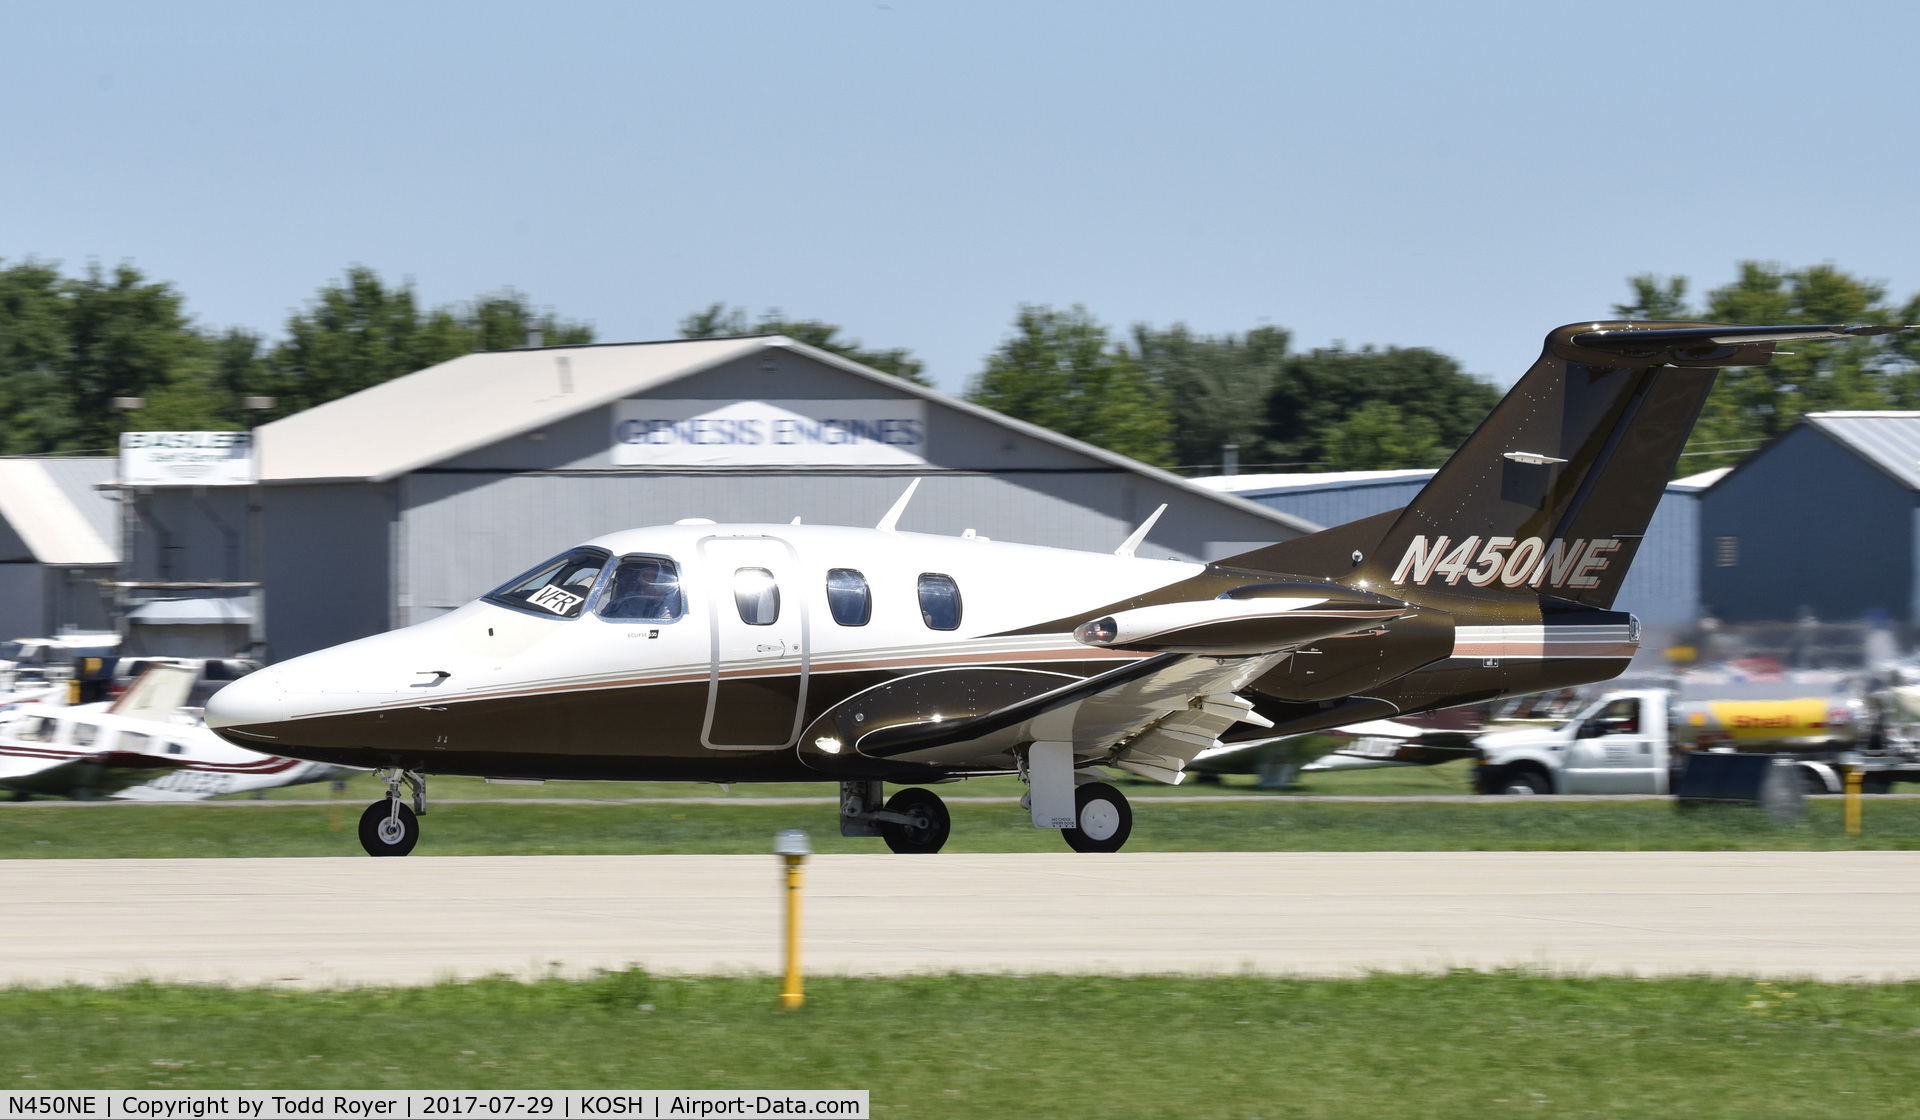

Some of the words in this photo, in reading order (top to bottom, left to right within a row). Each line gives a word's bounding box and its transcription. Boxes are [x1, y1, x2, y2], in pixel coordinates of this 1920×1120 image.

[616, 419, 763, 445] GENESIS
[774, 419, 925, 445] ENGINES
[1390, 535, 1622, 588] N450NE
[535, 587, 577, 612] VFR
